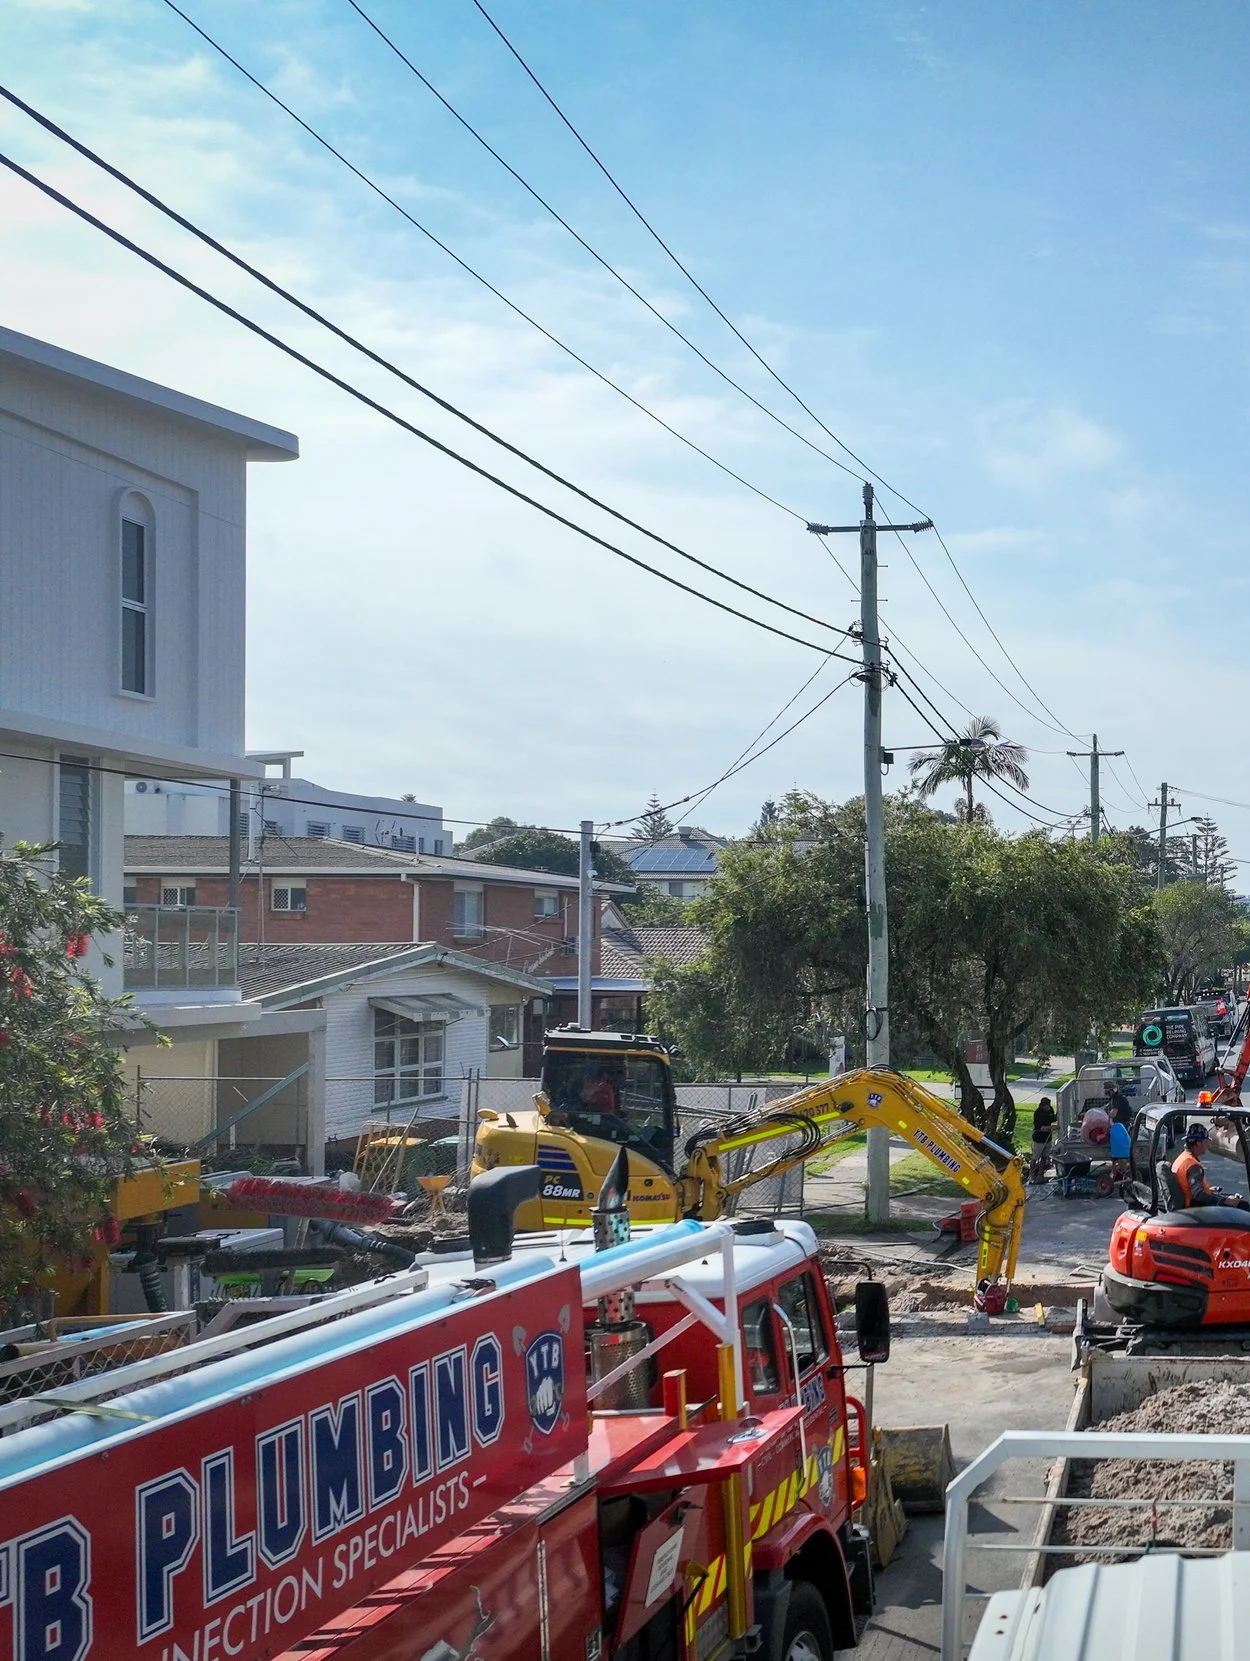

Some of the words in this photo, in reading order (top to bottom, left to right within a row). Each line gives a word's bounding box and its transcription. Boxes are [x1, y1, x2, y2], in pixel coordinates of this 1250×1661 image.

[912, 1127, 929, 1145] YTB
[926, 1140, 961, 1173] PLUMBING
[543, 1185, 580, 1198] 88MR
[544, 1176, 560, 1184] PC
[632, 1193, 670, 1202] KOMATSU
[529, 1342, 560, 1379] YTB
[135, 1332, 505, 1647] PLUMBING
[332, 1471, 470, 1589] SPECIALISTS
